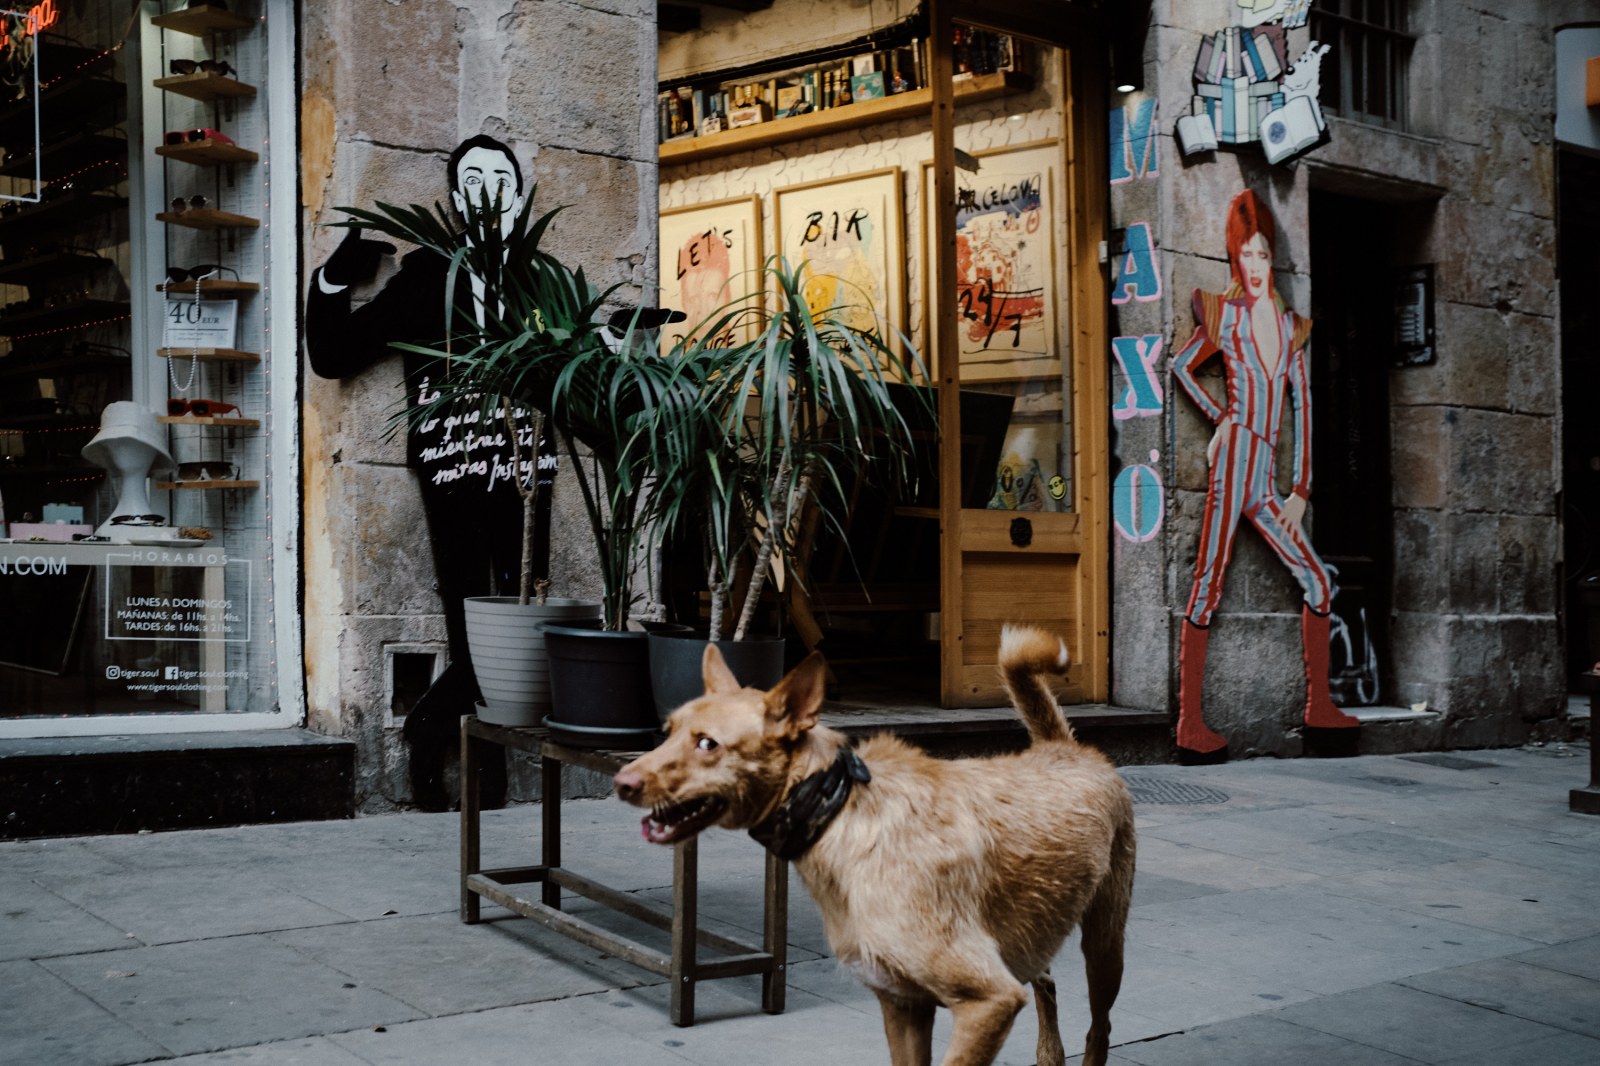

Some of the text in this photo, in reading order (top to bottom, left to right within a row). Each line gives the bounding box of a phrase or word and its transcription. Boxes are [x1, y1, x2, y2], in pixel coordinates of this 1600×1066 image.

[677, 227, 733, 280] LET'S
[169, 302, 220, 324] 40 EUR
[959, 279, 1023, 348] 24/7
[443, 410, 480, 444] que
[432, 453, 559, 492] miras Instagam
[132, 551, 228, 565] HORARIOS
[126, 597, 232, 609] LUNES A DOMINGOS
[117, 609, 169, 620] MAÑANAS:
[171, 612, 183, 620] de
[125, 621, 163, 631] TARDES:
[164, 622, 176, 631] de
[121, 669, 159, 679] tiger.soul
